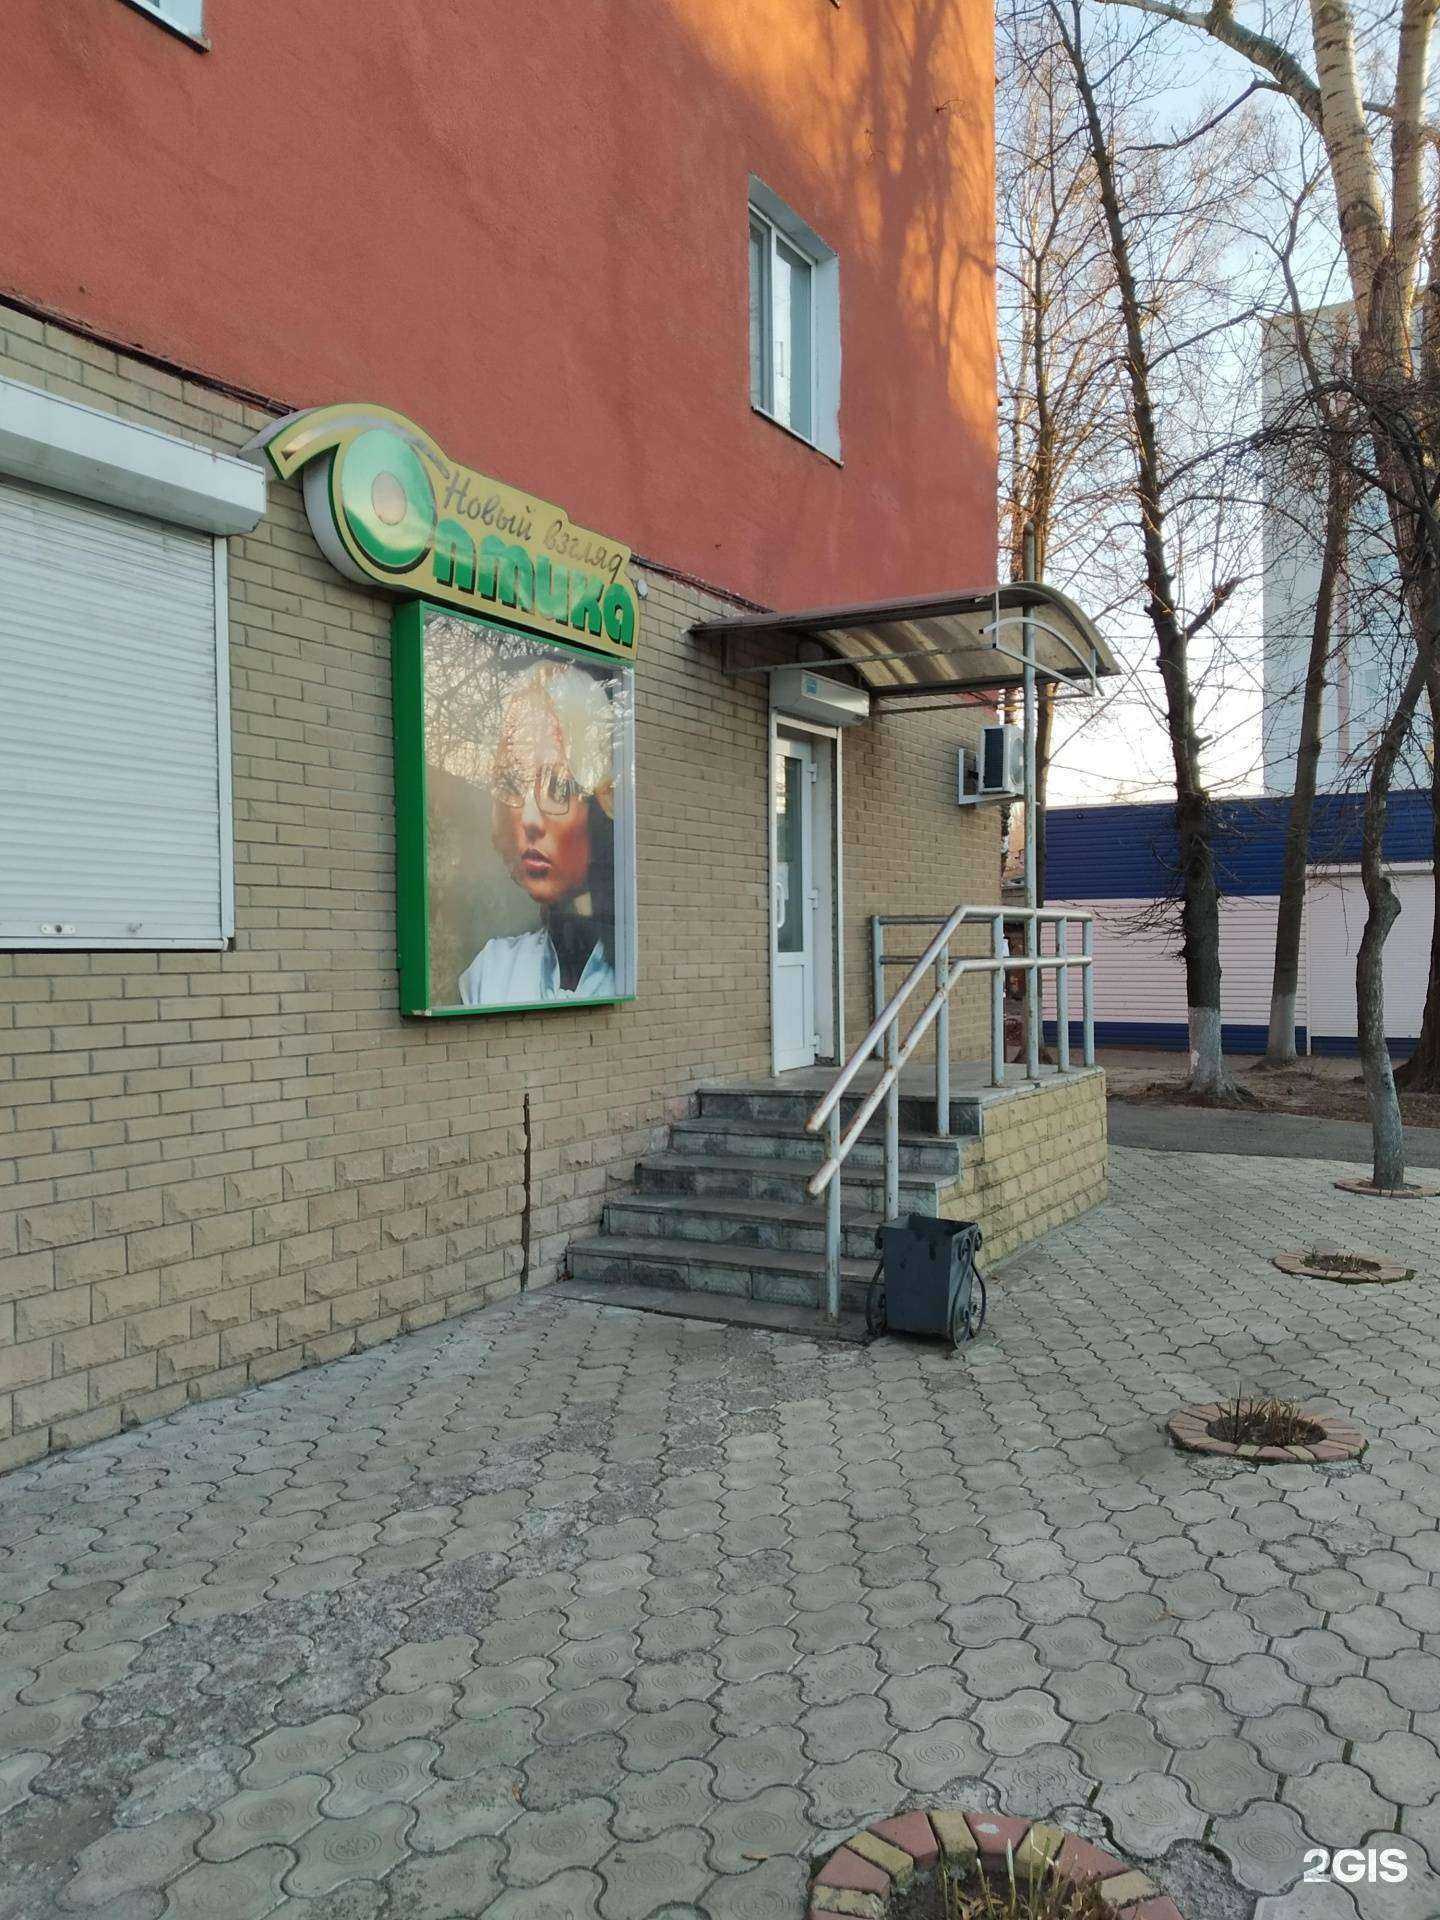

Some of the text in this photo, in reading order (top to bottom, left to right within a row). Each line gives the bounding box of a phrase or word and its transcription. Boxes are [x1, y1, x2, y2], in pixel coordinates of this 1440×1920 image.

[340, 427, 636, 649] Оптика
[443, 471, 624, 585] Новый взгляд
